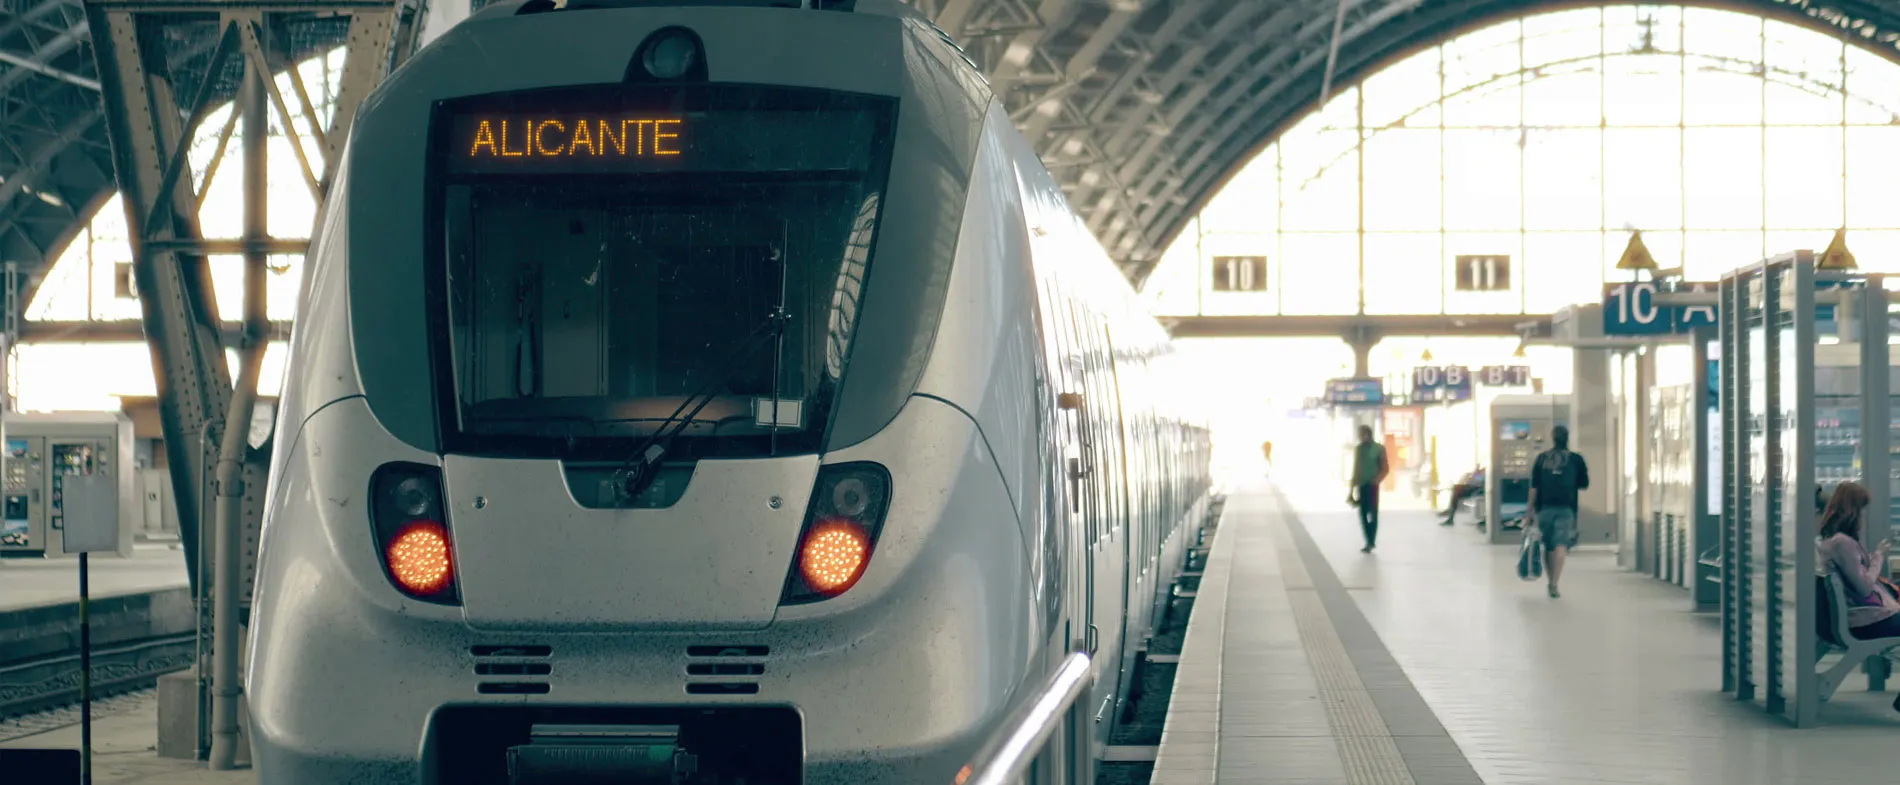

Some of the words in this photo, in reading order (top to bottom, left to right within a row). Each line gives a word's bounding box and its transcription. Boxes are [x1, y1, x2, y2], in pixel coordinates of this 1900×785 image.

[471, 119, 681, 156] ALICANTE
[1226, 259, 1254, 290] 10
[1470, 258, 1496, 290] 11
[1610, 283, 1659, 324] 10
[1682, 283, 1716, 323] A
[1416, 366, 1438, 386] 10
[1446, 366, 1462, 385] B
[1488, 366, 1504, 385] B
